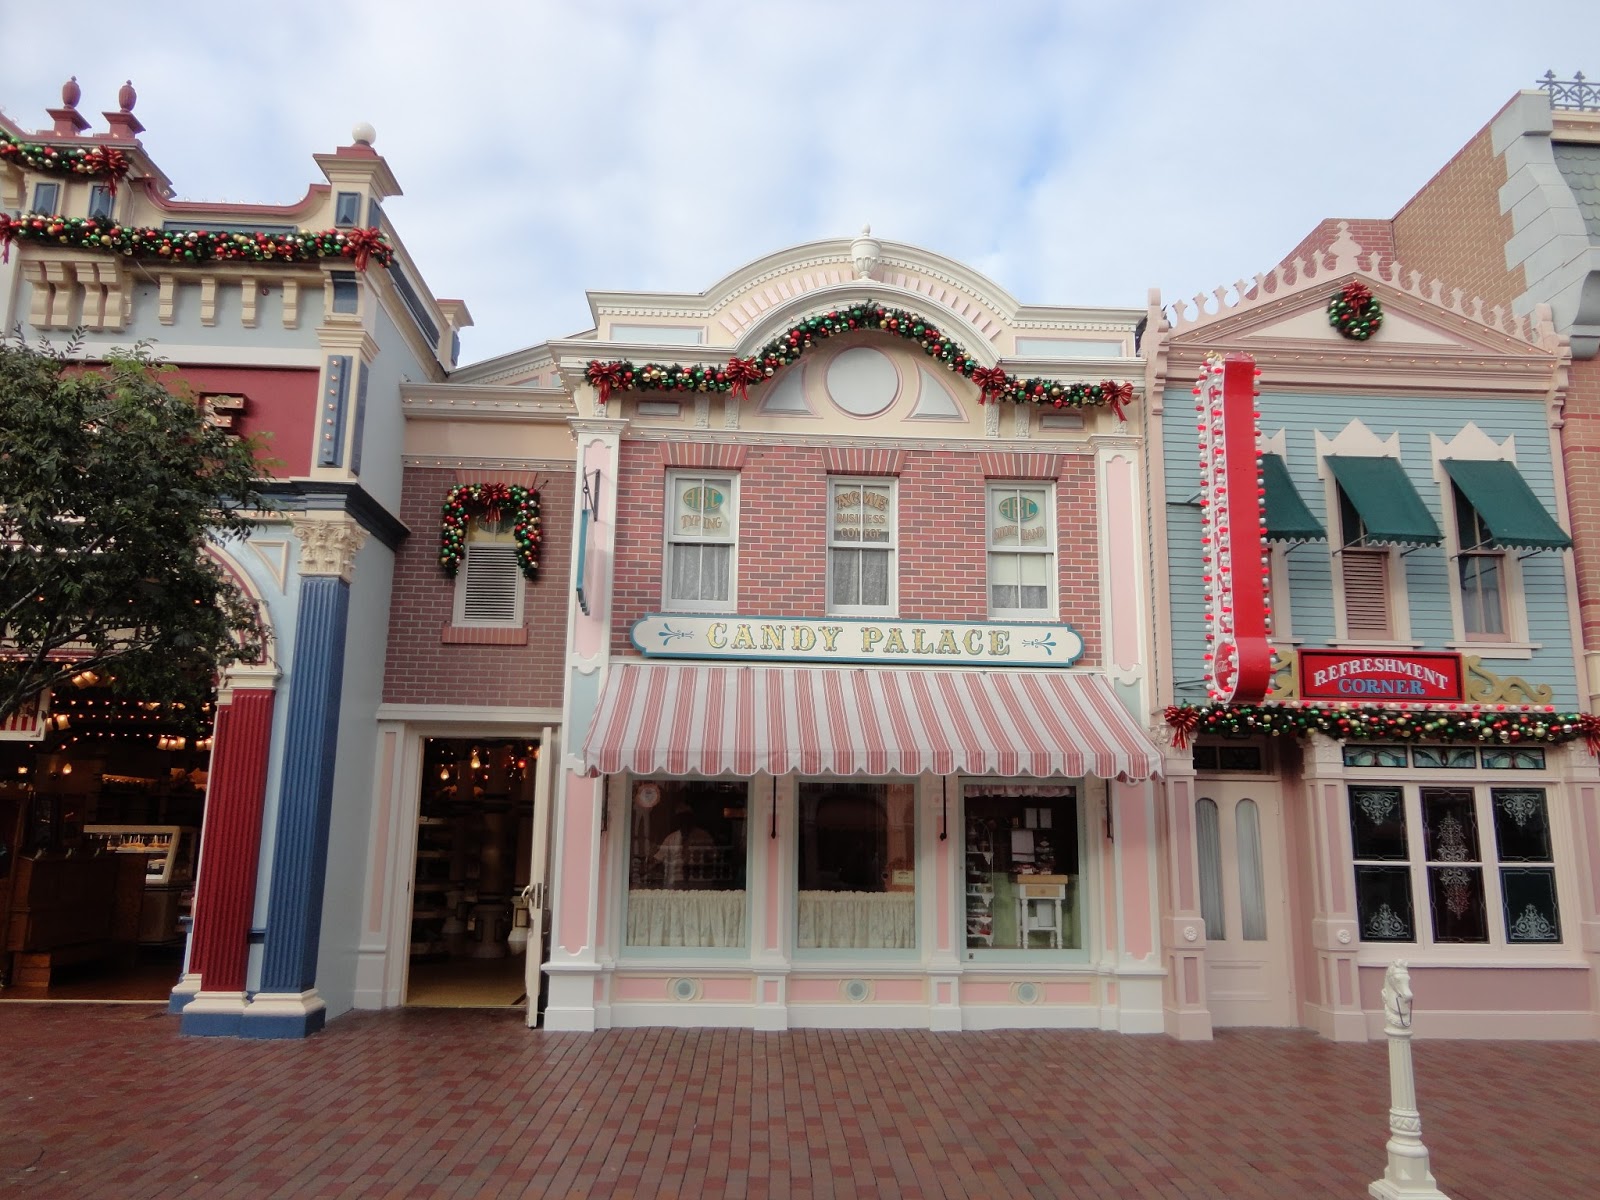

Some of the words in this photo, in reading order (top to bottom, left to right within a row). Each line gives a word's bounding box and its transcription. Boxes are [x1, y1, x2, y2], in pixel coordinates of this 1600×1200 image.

[683, 486, 722, 511] ABC
[835, 491, 888, 511] ACME
[836, 513, 886, 524] BUSINESS
[999, 497, 1037, 521] ABC
[681, 515, 722, 529] TYPING
[840, 528, 882, 538] COLEGE
[706, 622, 843, 652] CANDY
[860, 627, 1010, 655] PALACE
[1313, 658, 1448, 690] REFRESHMENT
[1338, 678, 1425, 695] CORNER
